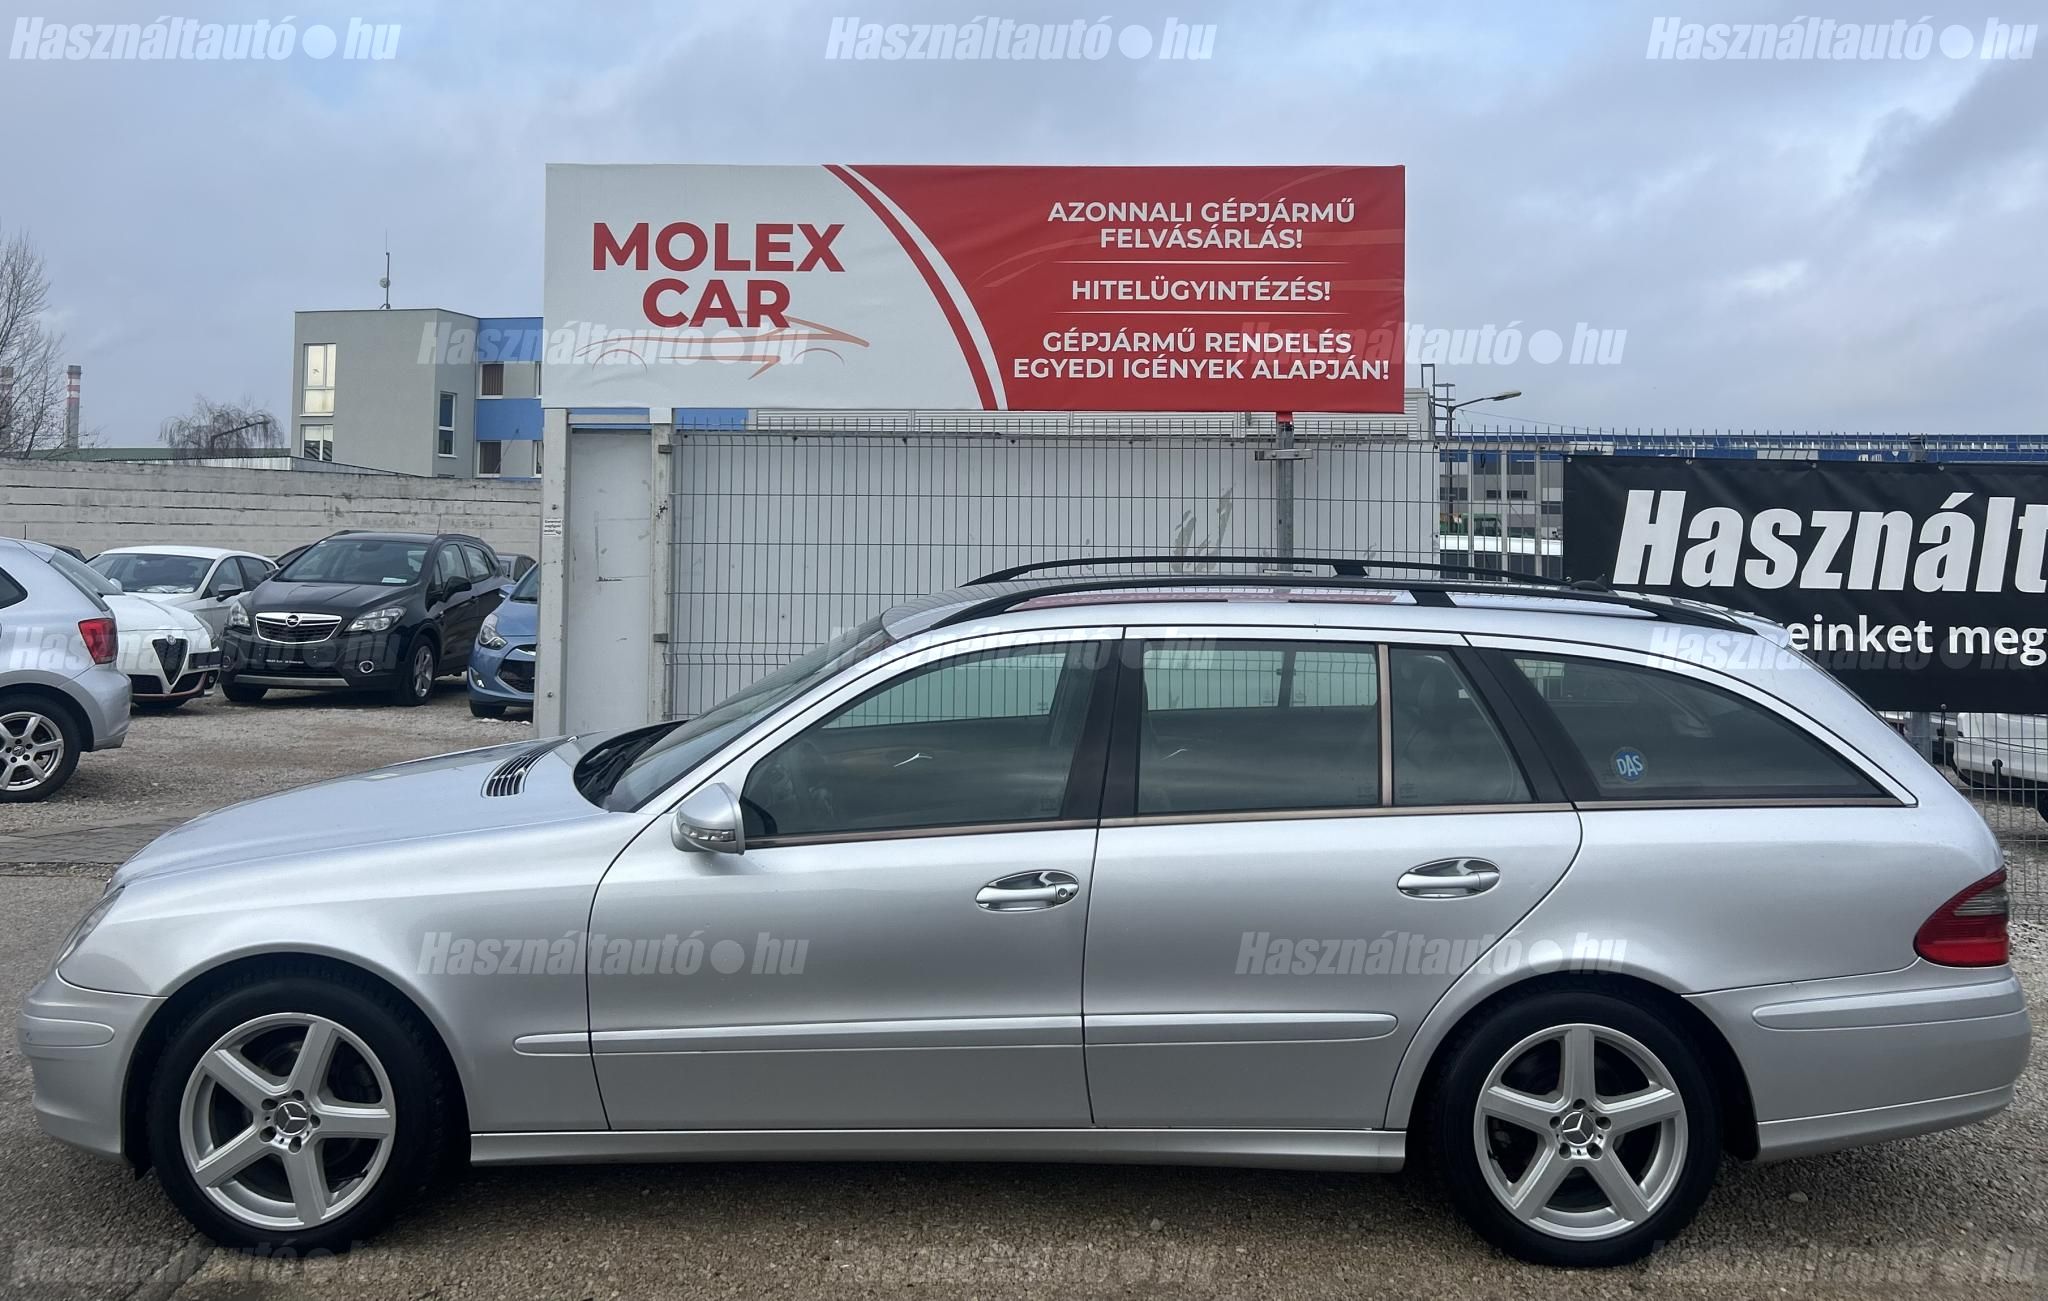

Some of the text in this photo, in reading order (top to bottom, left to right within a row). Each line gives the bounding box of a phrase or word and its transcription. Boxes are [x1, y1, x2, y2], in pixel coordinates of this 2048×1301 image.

[1048, 197, 1355, 223] AZONNALI GÉPJÁRMŰ
[592, 221, 845, 273] MOLEX
[1100, 224, 1303, 249] FELVÁSÁRLÁS!
[1072, 275, 1331, 302] HITELÜGYINTÉZÉS!
[642, 278, 791, 328] CAR
[1043, 327, 1352, 354] GÉPJÁRMŰ RENDELÉS
[1013, 352, 1390, 381] EGYEDI IGÉNYEK ALAPJÁN!
[1949, 626, 2048, 667] meg
